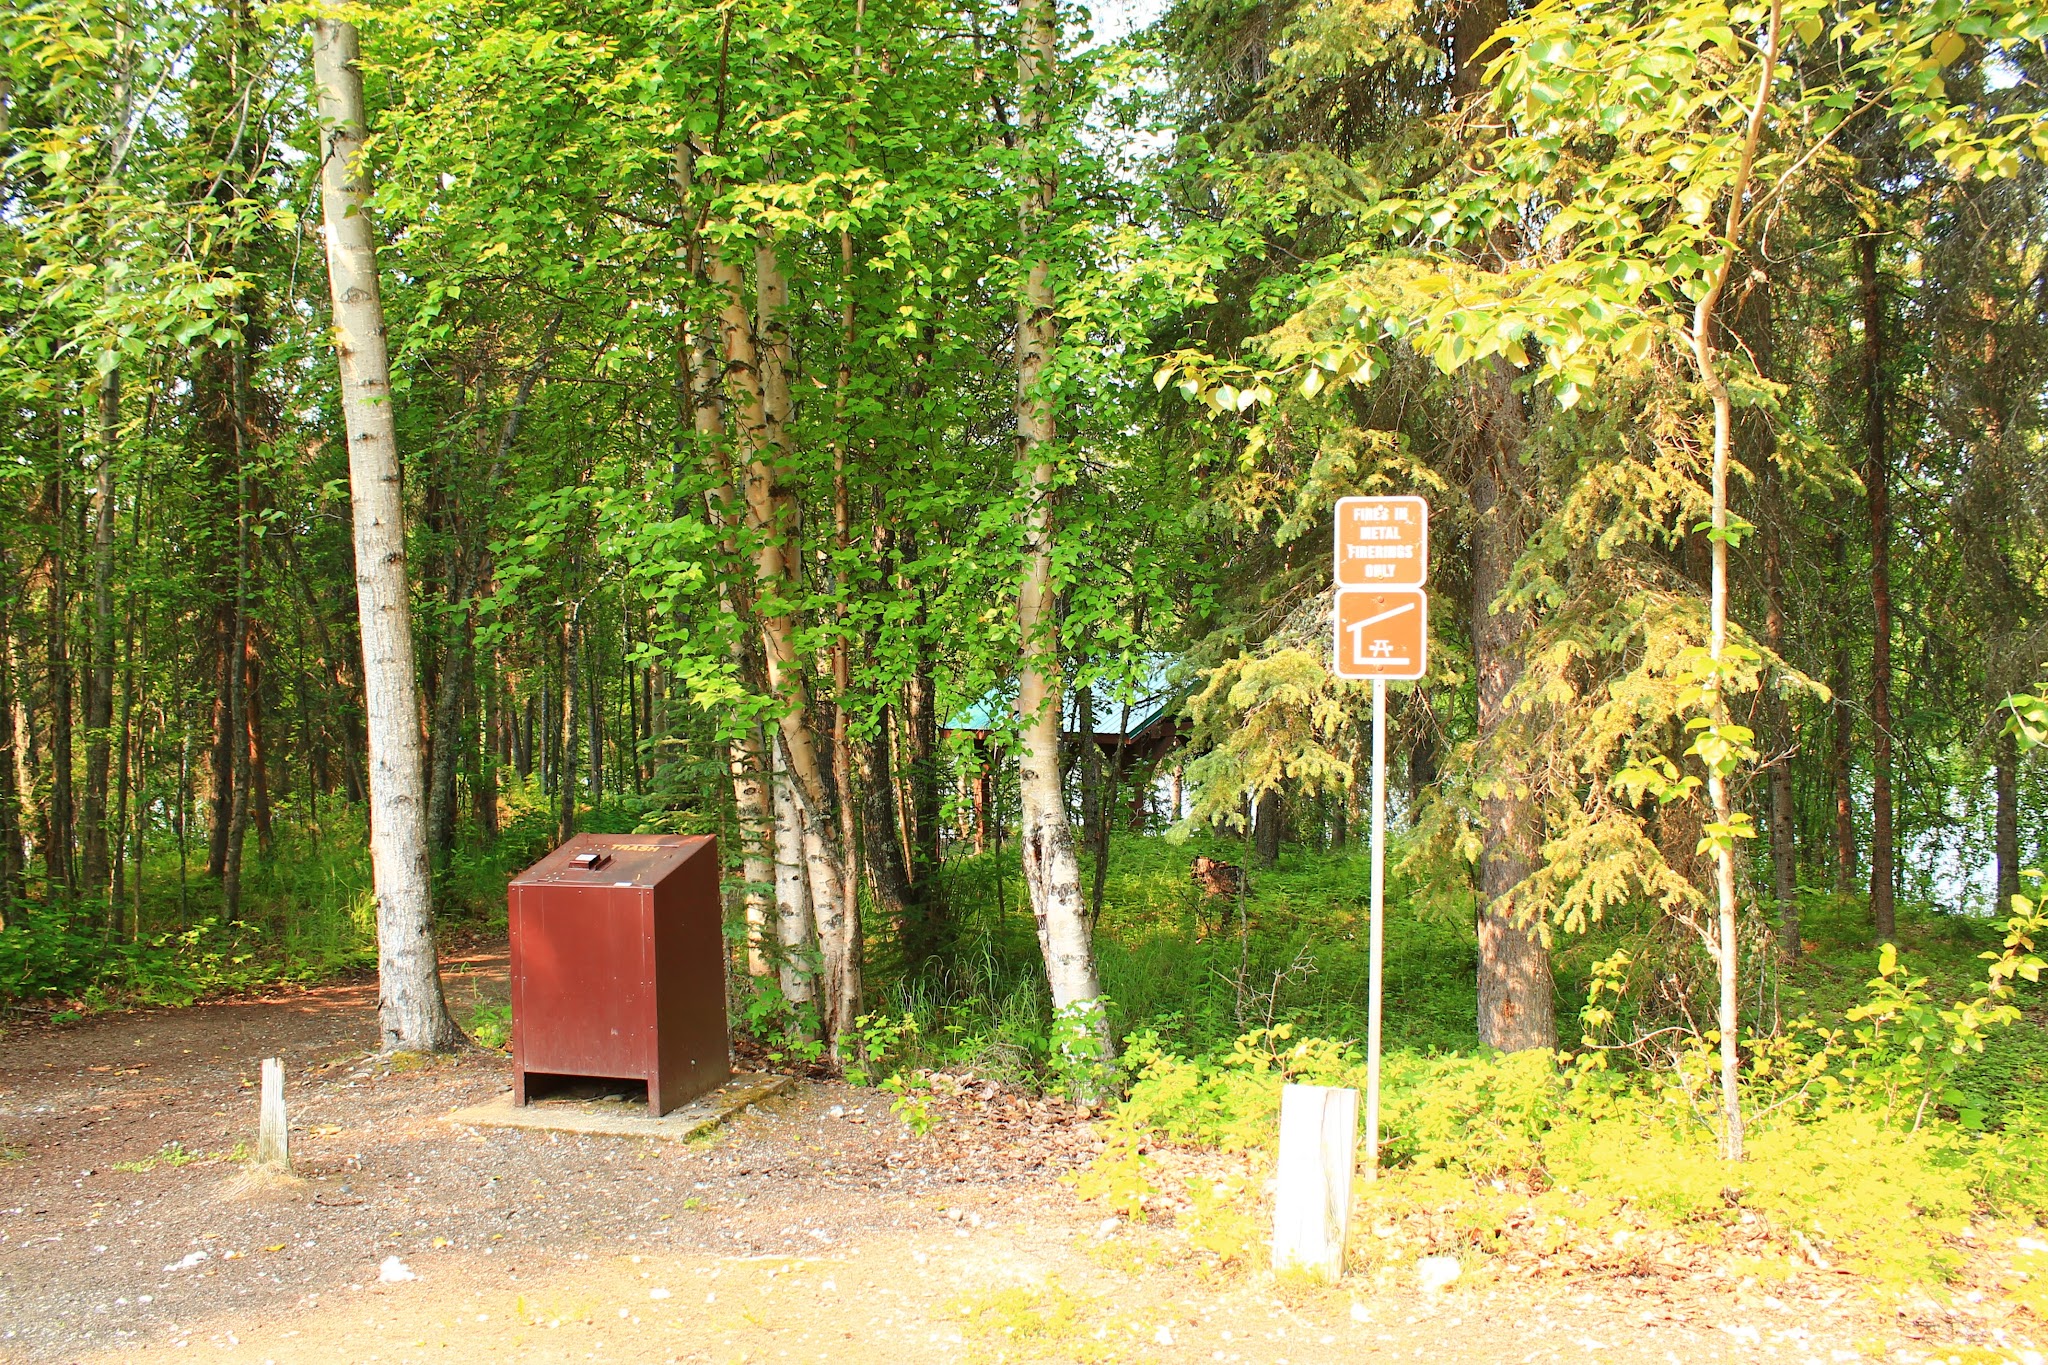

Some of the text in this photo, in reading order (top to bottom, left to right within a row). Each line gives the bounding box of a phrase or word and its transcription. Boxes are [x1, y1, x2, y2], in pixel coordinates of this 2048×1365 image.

[1353, 507, 1408, 521] FIRES IN
[1360, 526, 1401, 540] METAL
[1347, 545, 1413, 559] FIRERINGS
[1364, 564, 1396, 578] ONLY
[610, 843, 660, 853] TRASH
